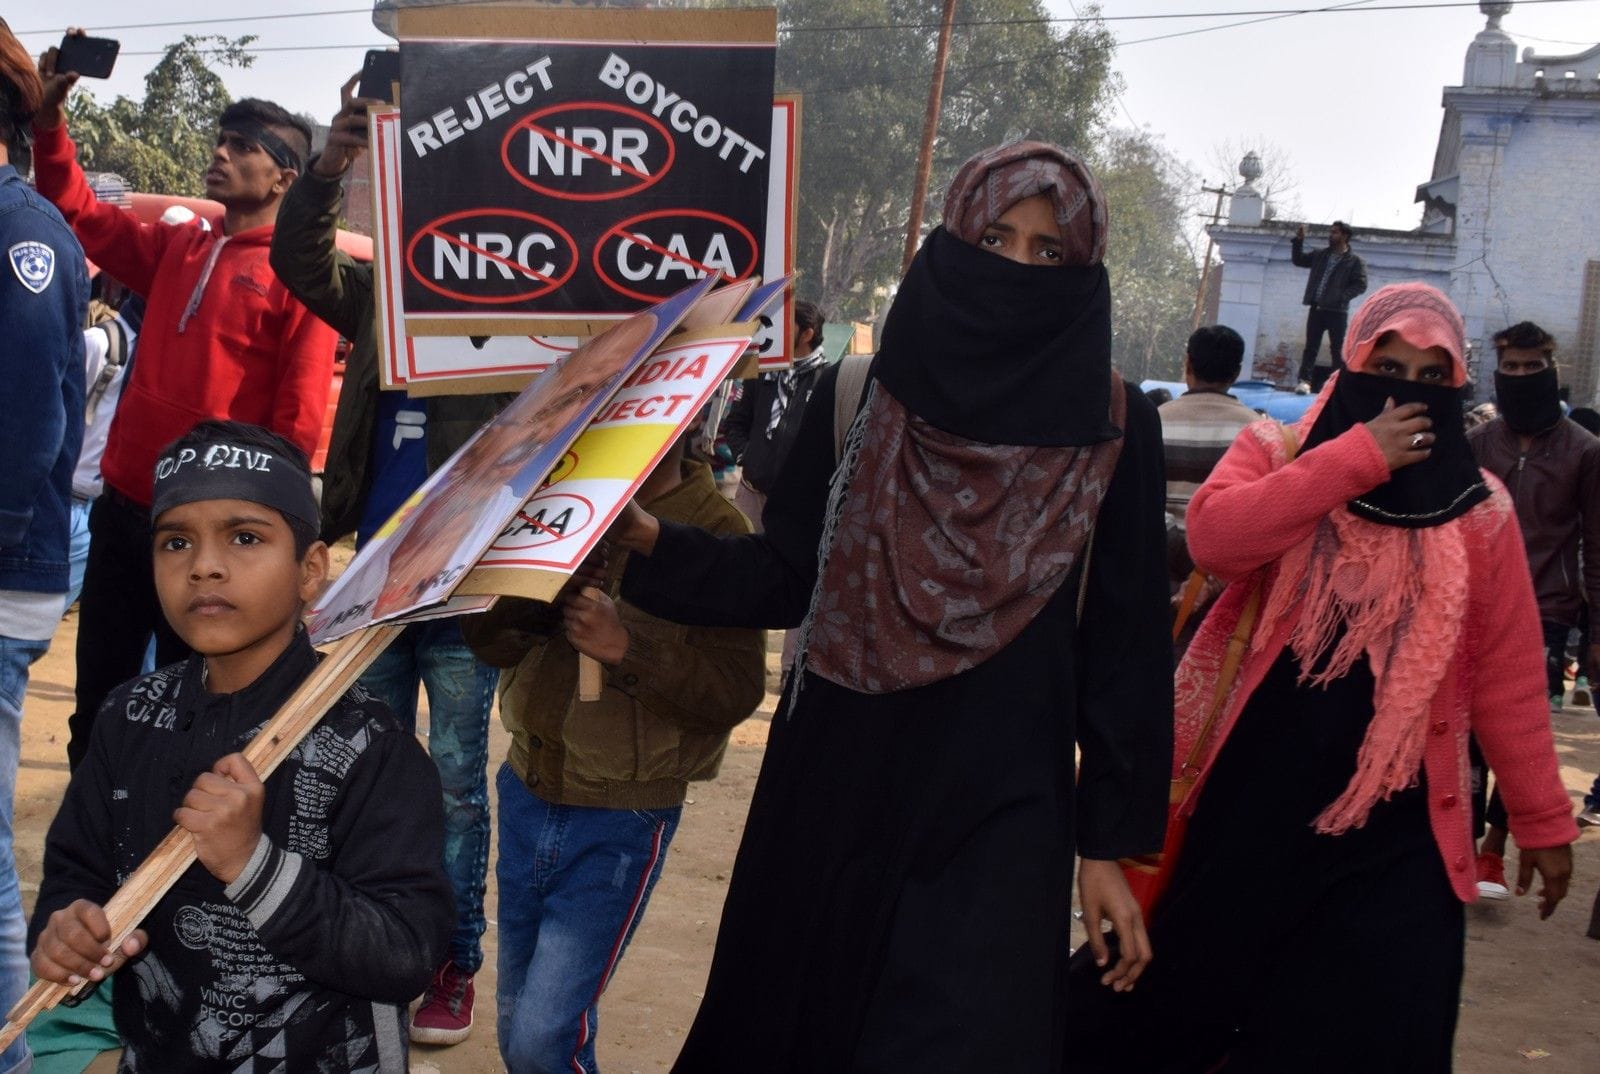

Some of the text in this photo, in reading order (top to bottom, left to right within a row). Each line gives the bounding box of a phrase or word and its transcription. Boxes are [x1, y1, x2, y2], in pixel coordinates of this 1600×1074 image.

[406, 55, 553, 158] REJECT
[598, 52, 766, 174] BOYCOTT
[528, 126, 650, 177] NPR
[433, 232, 556, 281] NRC
[616, 232, 736, 282] CAA
[622, 354, 710, 389] NDIA
[592, 394, 693, 424] JECT
[154, 448, 197, 484] OP
